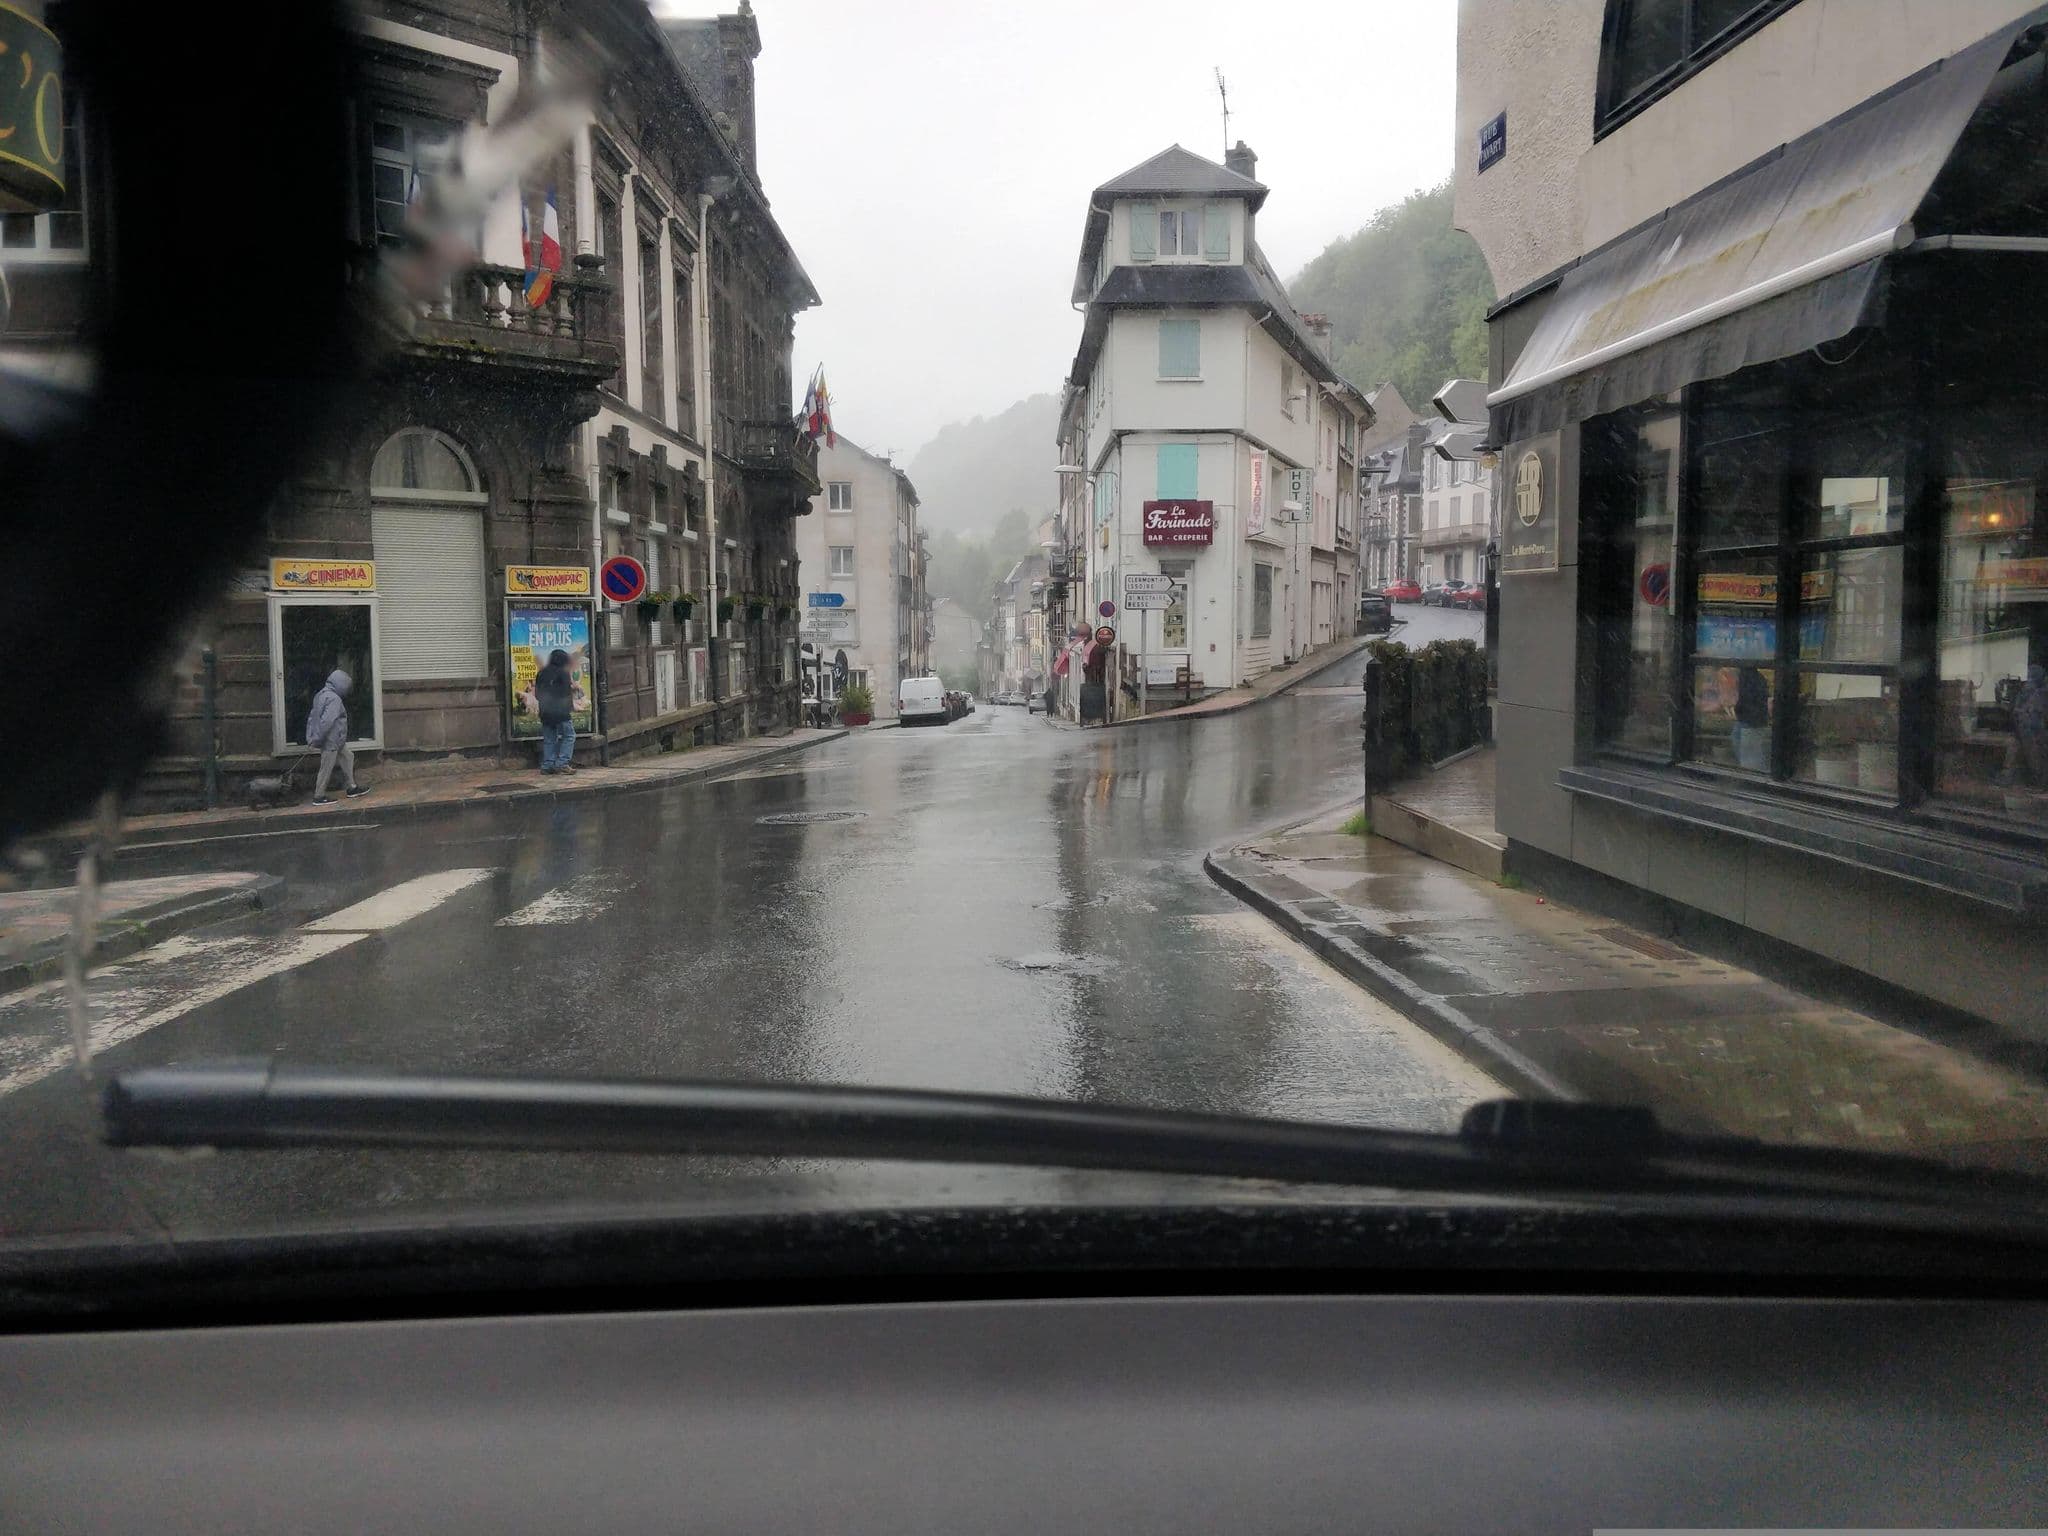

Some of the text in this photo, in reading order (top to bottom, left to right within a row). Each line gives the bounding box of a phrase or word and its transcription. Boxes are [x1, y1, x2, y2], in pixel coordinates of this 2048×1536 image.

[1483, 121, 1498, 144] RUE
[1292, 471, 1301, 521] HOTL
[1171, 505, 1186, 516] La
[1145, 509, 1211, 529] Farinade
[308, 567, 367, 584] CINEMA
[533, 573, 584, 589] OLYMPIC
[529, 623, 539, 632] UN
[556, 623, 571, 632] TRUC
[529, 632, 572, 647] EN PLUS
